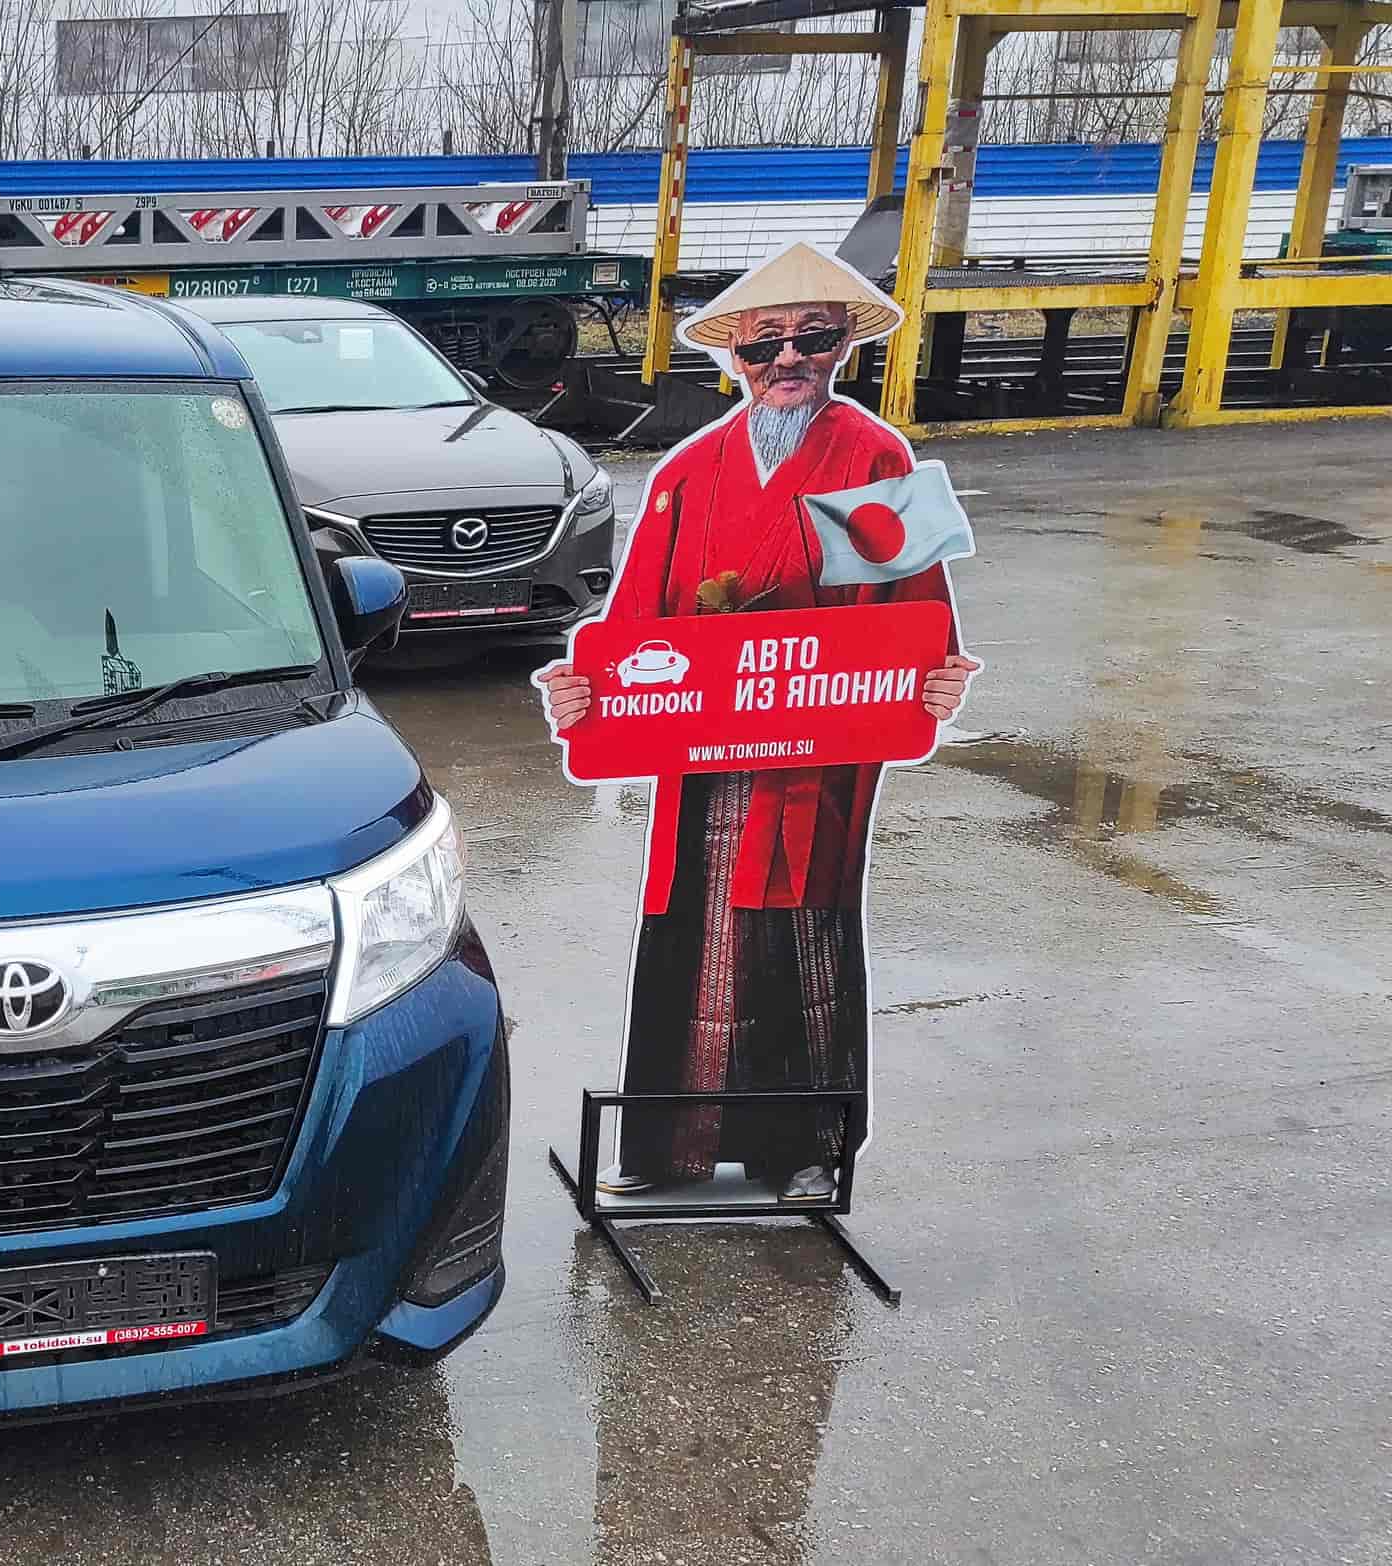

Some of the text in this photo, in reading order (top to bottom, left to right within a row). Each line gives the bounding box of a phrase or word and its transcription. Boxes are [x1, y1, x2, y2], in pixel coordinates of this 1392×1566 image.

[9, 197, 83, 211] VGKU 001487 5
[174, 279, 250, 296] 91281097
[287, 277, 318, 293] [27]
[736, 636, 820, 674] АВТО
[734, 667, 917, 712] ИЗ ЯПОНИИ
[599, 690, 703, 719] TOKIDOKI
[688, 740, 814, 762] WWW.TOKIDOKI.SU
[114, 1323, 198, 1340] (383)2-555-007
[23, 1334, 103, 1351] tokidoki.su
